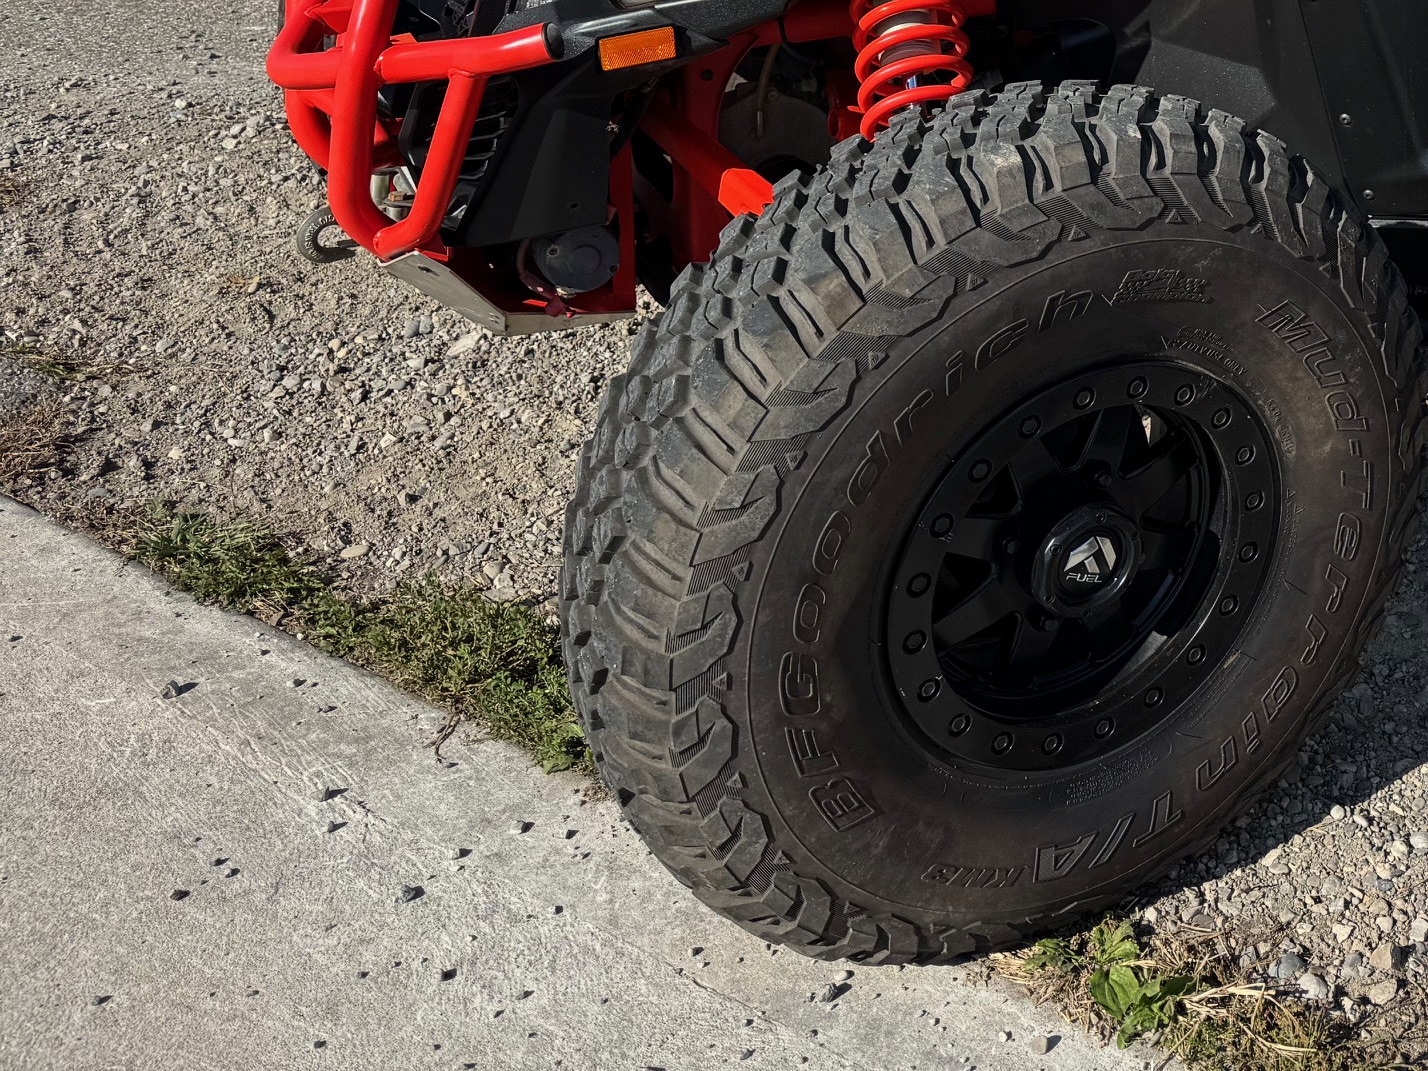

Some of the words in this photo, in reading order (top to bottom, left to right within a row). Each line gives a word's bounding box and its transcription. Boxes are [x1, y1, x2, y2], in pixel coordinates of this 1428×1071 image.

[778, 289, 1096, 832] BFGoodrich
[1066, 572, 1103, 583] FUEL
[1032, 790, 1182, 884] T/A
